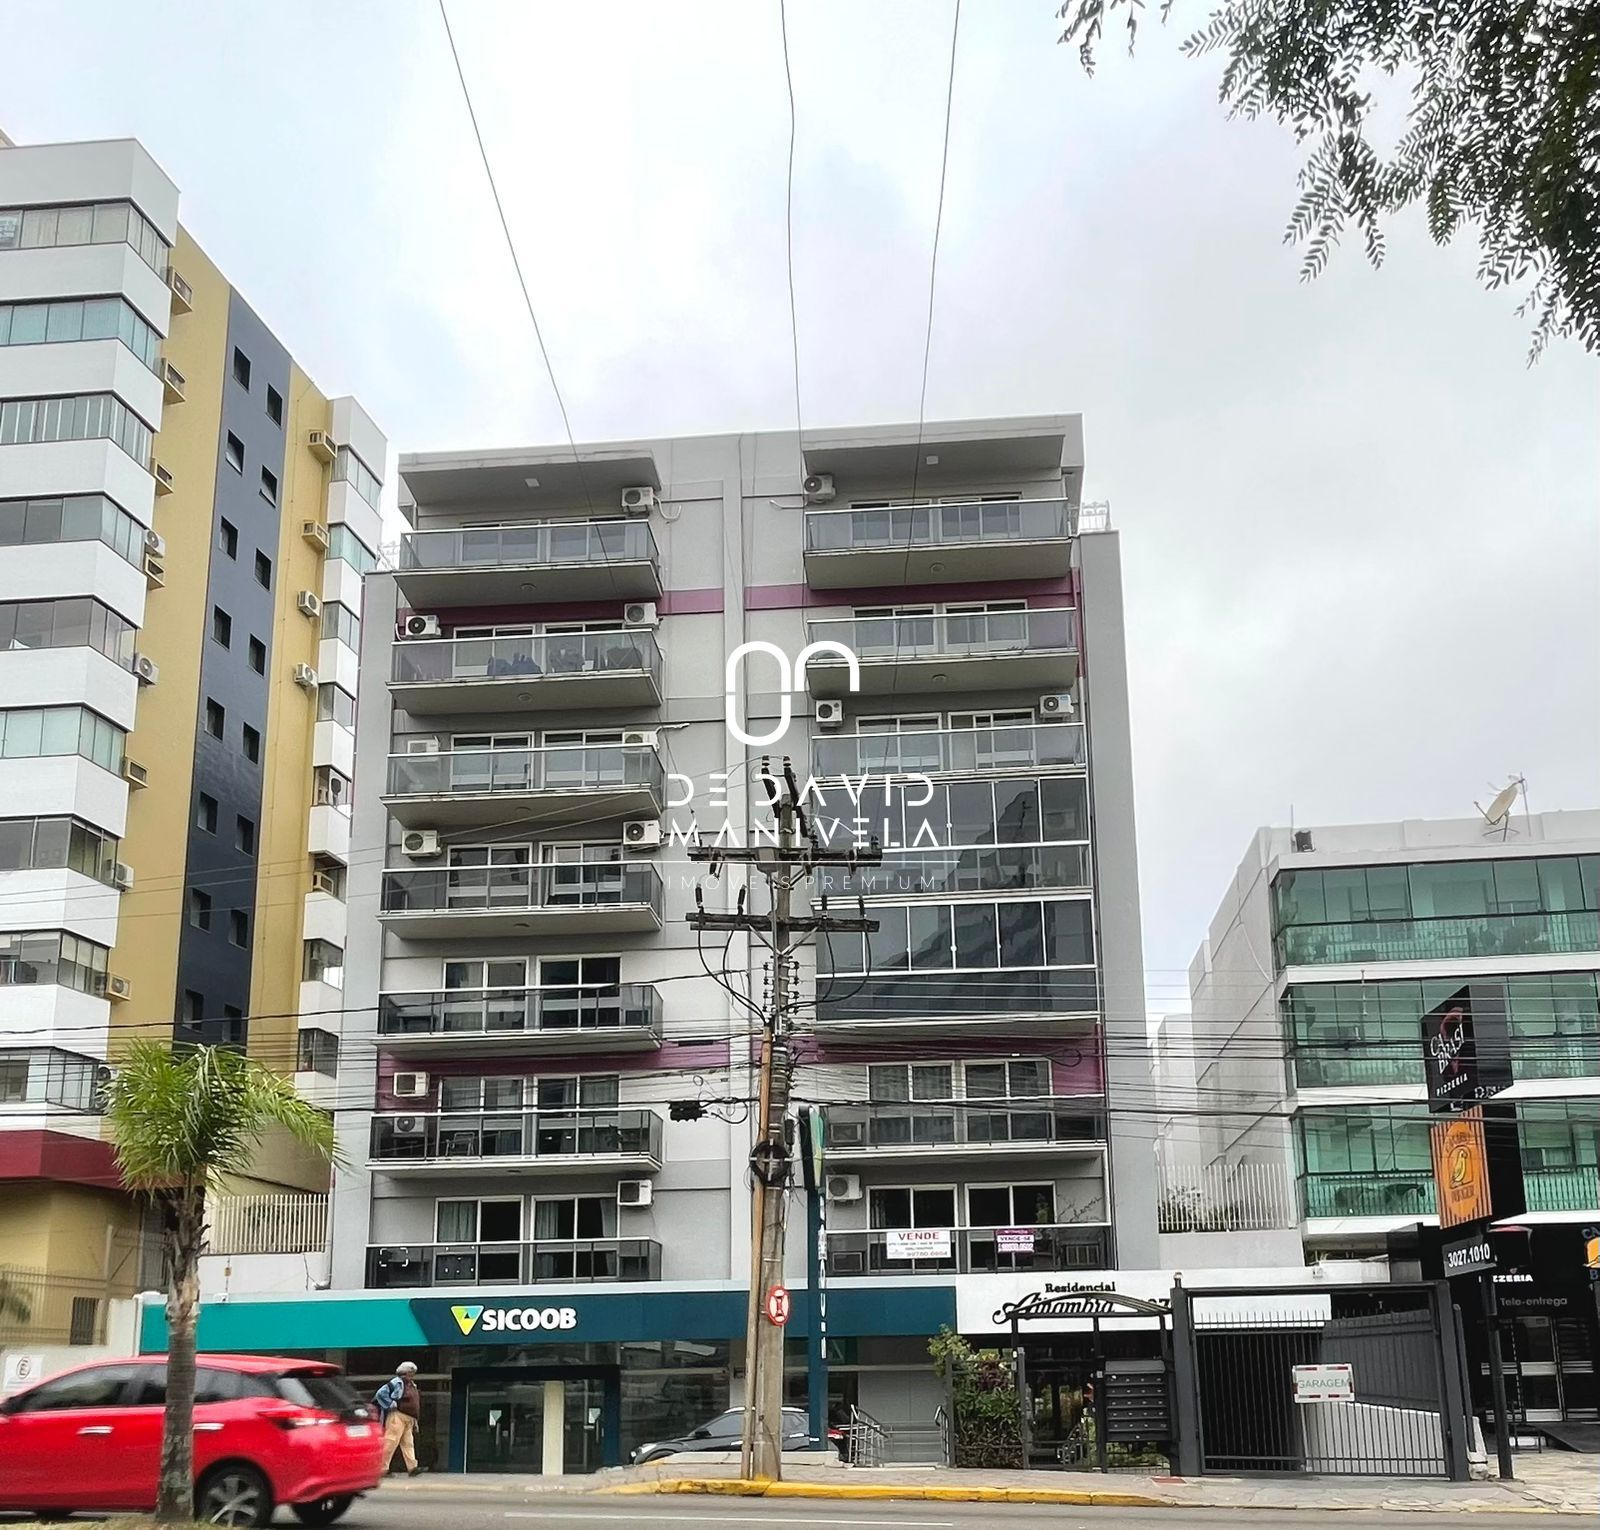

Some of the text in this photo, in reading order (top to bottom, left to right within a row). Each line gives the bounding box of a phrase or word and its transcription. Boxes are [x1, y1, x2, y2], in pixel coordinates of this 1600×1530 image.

[1436, 1073, 1469, 1097] PIZZERIA
[898, 1231, 940, 1241] VENDE
[1447, 1243, 1491, 1268] 3027.1010
[1045, 1281, 1116, 1293] Residencial
[1500, 1297, 1568, 1307] Tele-entrega
[481, 1307, 577, 1331] SICOOB
[1298, 1378, 1351, 1389] GARAGEM
